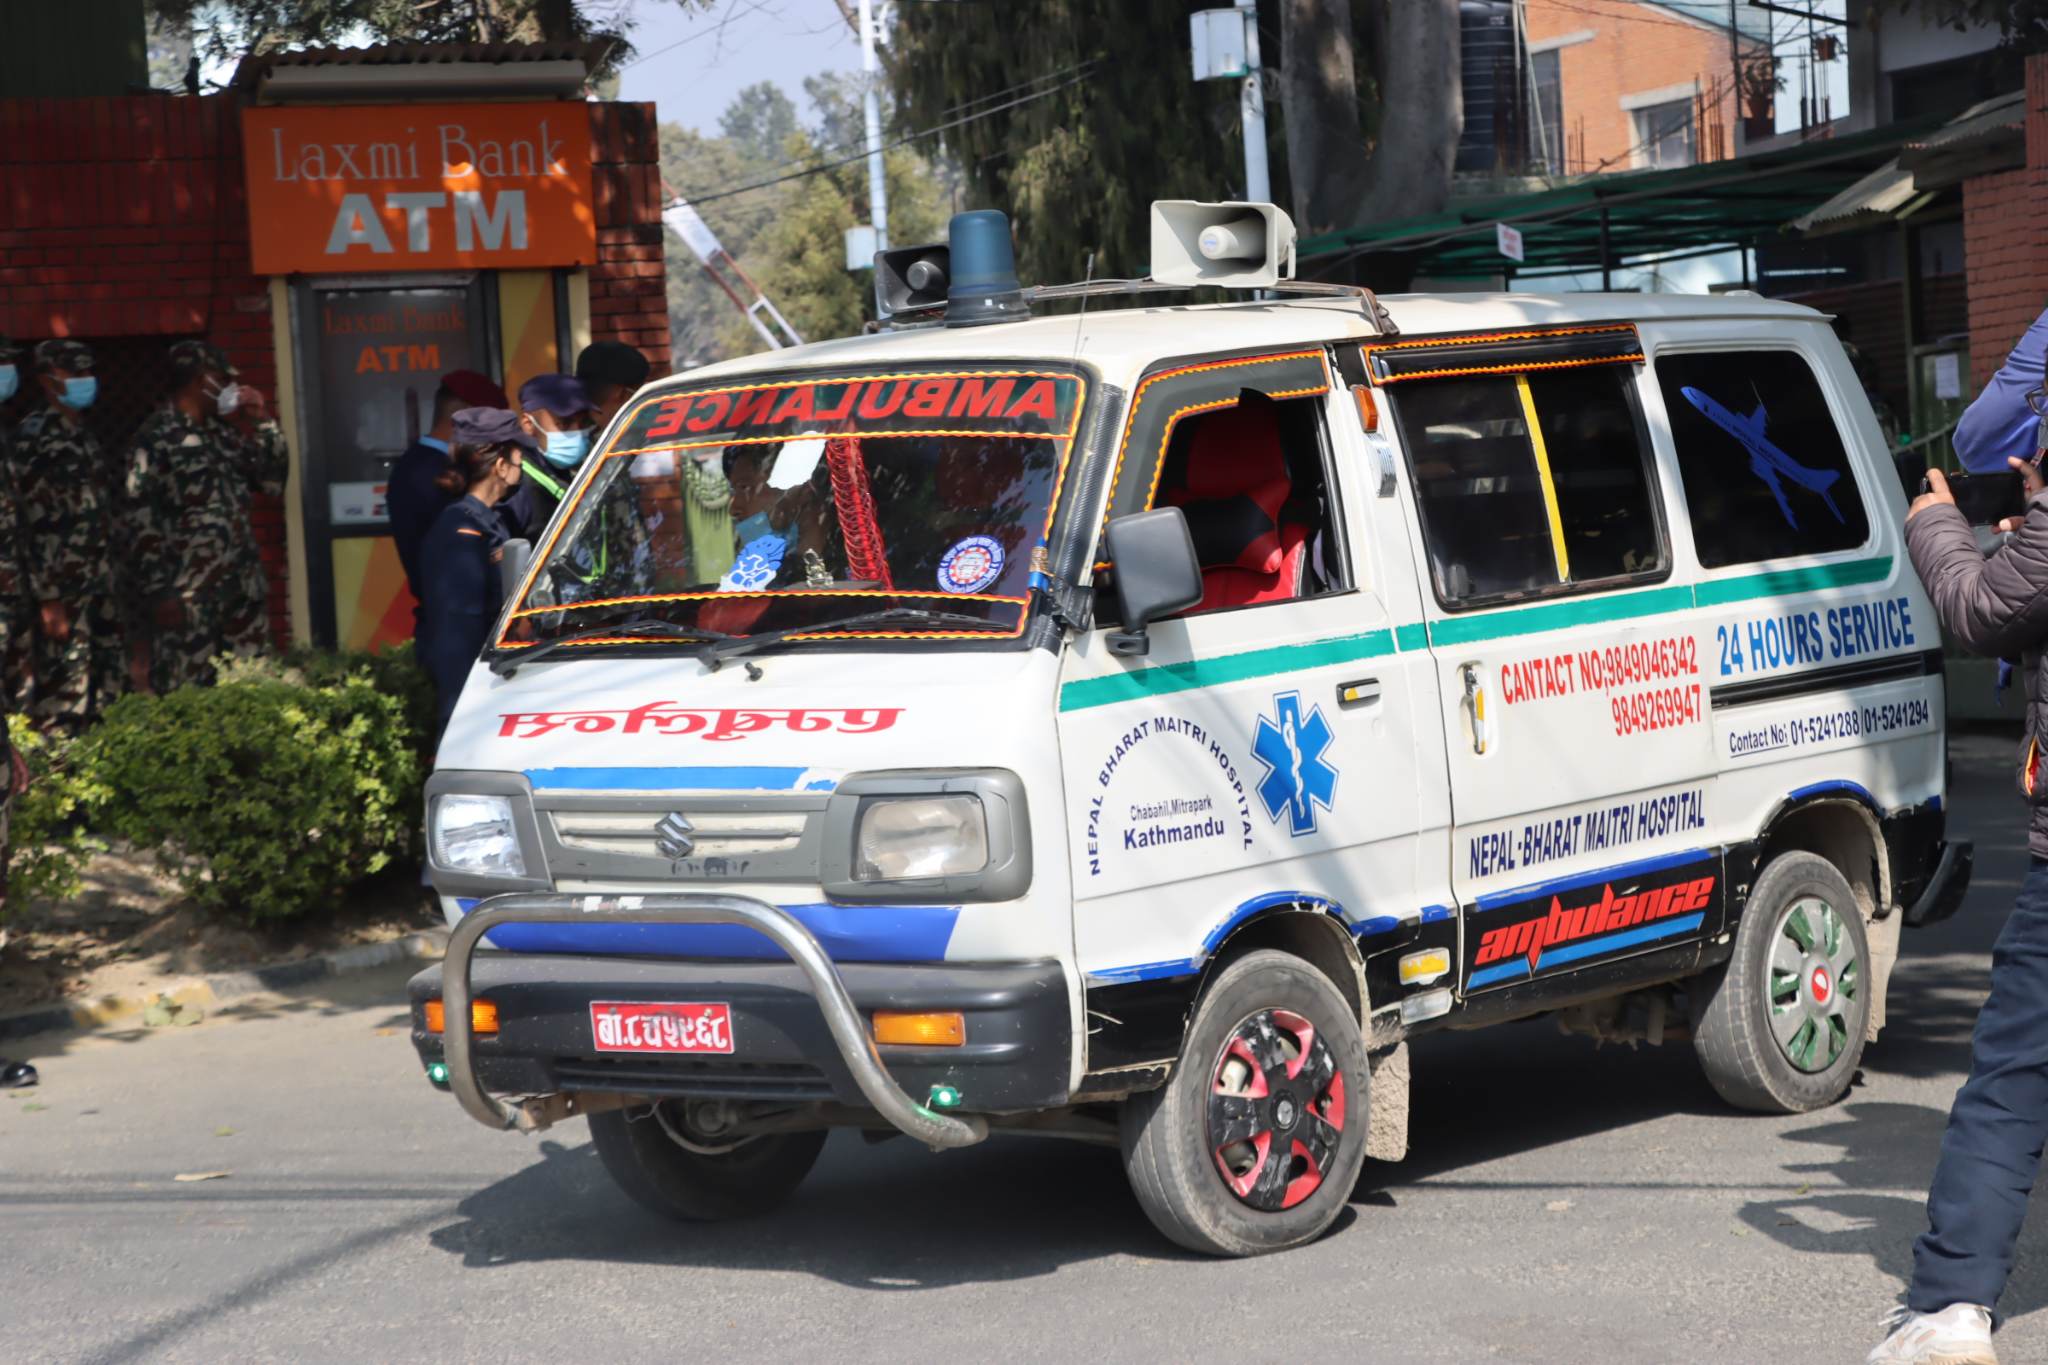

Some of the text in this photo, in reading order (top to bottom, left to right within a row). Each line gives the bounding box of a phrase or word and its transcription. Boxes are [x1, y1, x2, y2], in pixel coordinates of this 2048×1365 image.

[272, 120, 569, 181] Laxmi Bank
[324, 189, 529, 255] ATM
[356, 344, 441, 374] ATM
[1717, 597, 1915, 676] 24 HOURS SERVICE
[1501, 654, 1575, 704] CANTACT
[1611, 684, 1701, 736] 9849269947
[1730, 727, 1768, 753] Contact
[1087, 717, 1253, 876] NEPAL BHARAT MAITRI HOSPITAL
[1584, 804, 1635, 853] MAITRI
[1637, 790, 1705, 841] HOSPITAL
[1124, 816, 1225, 849] Kathmandu
[1474, 876, 1715, 969] ambulance
